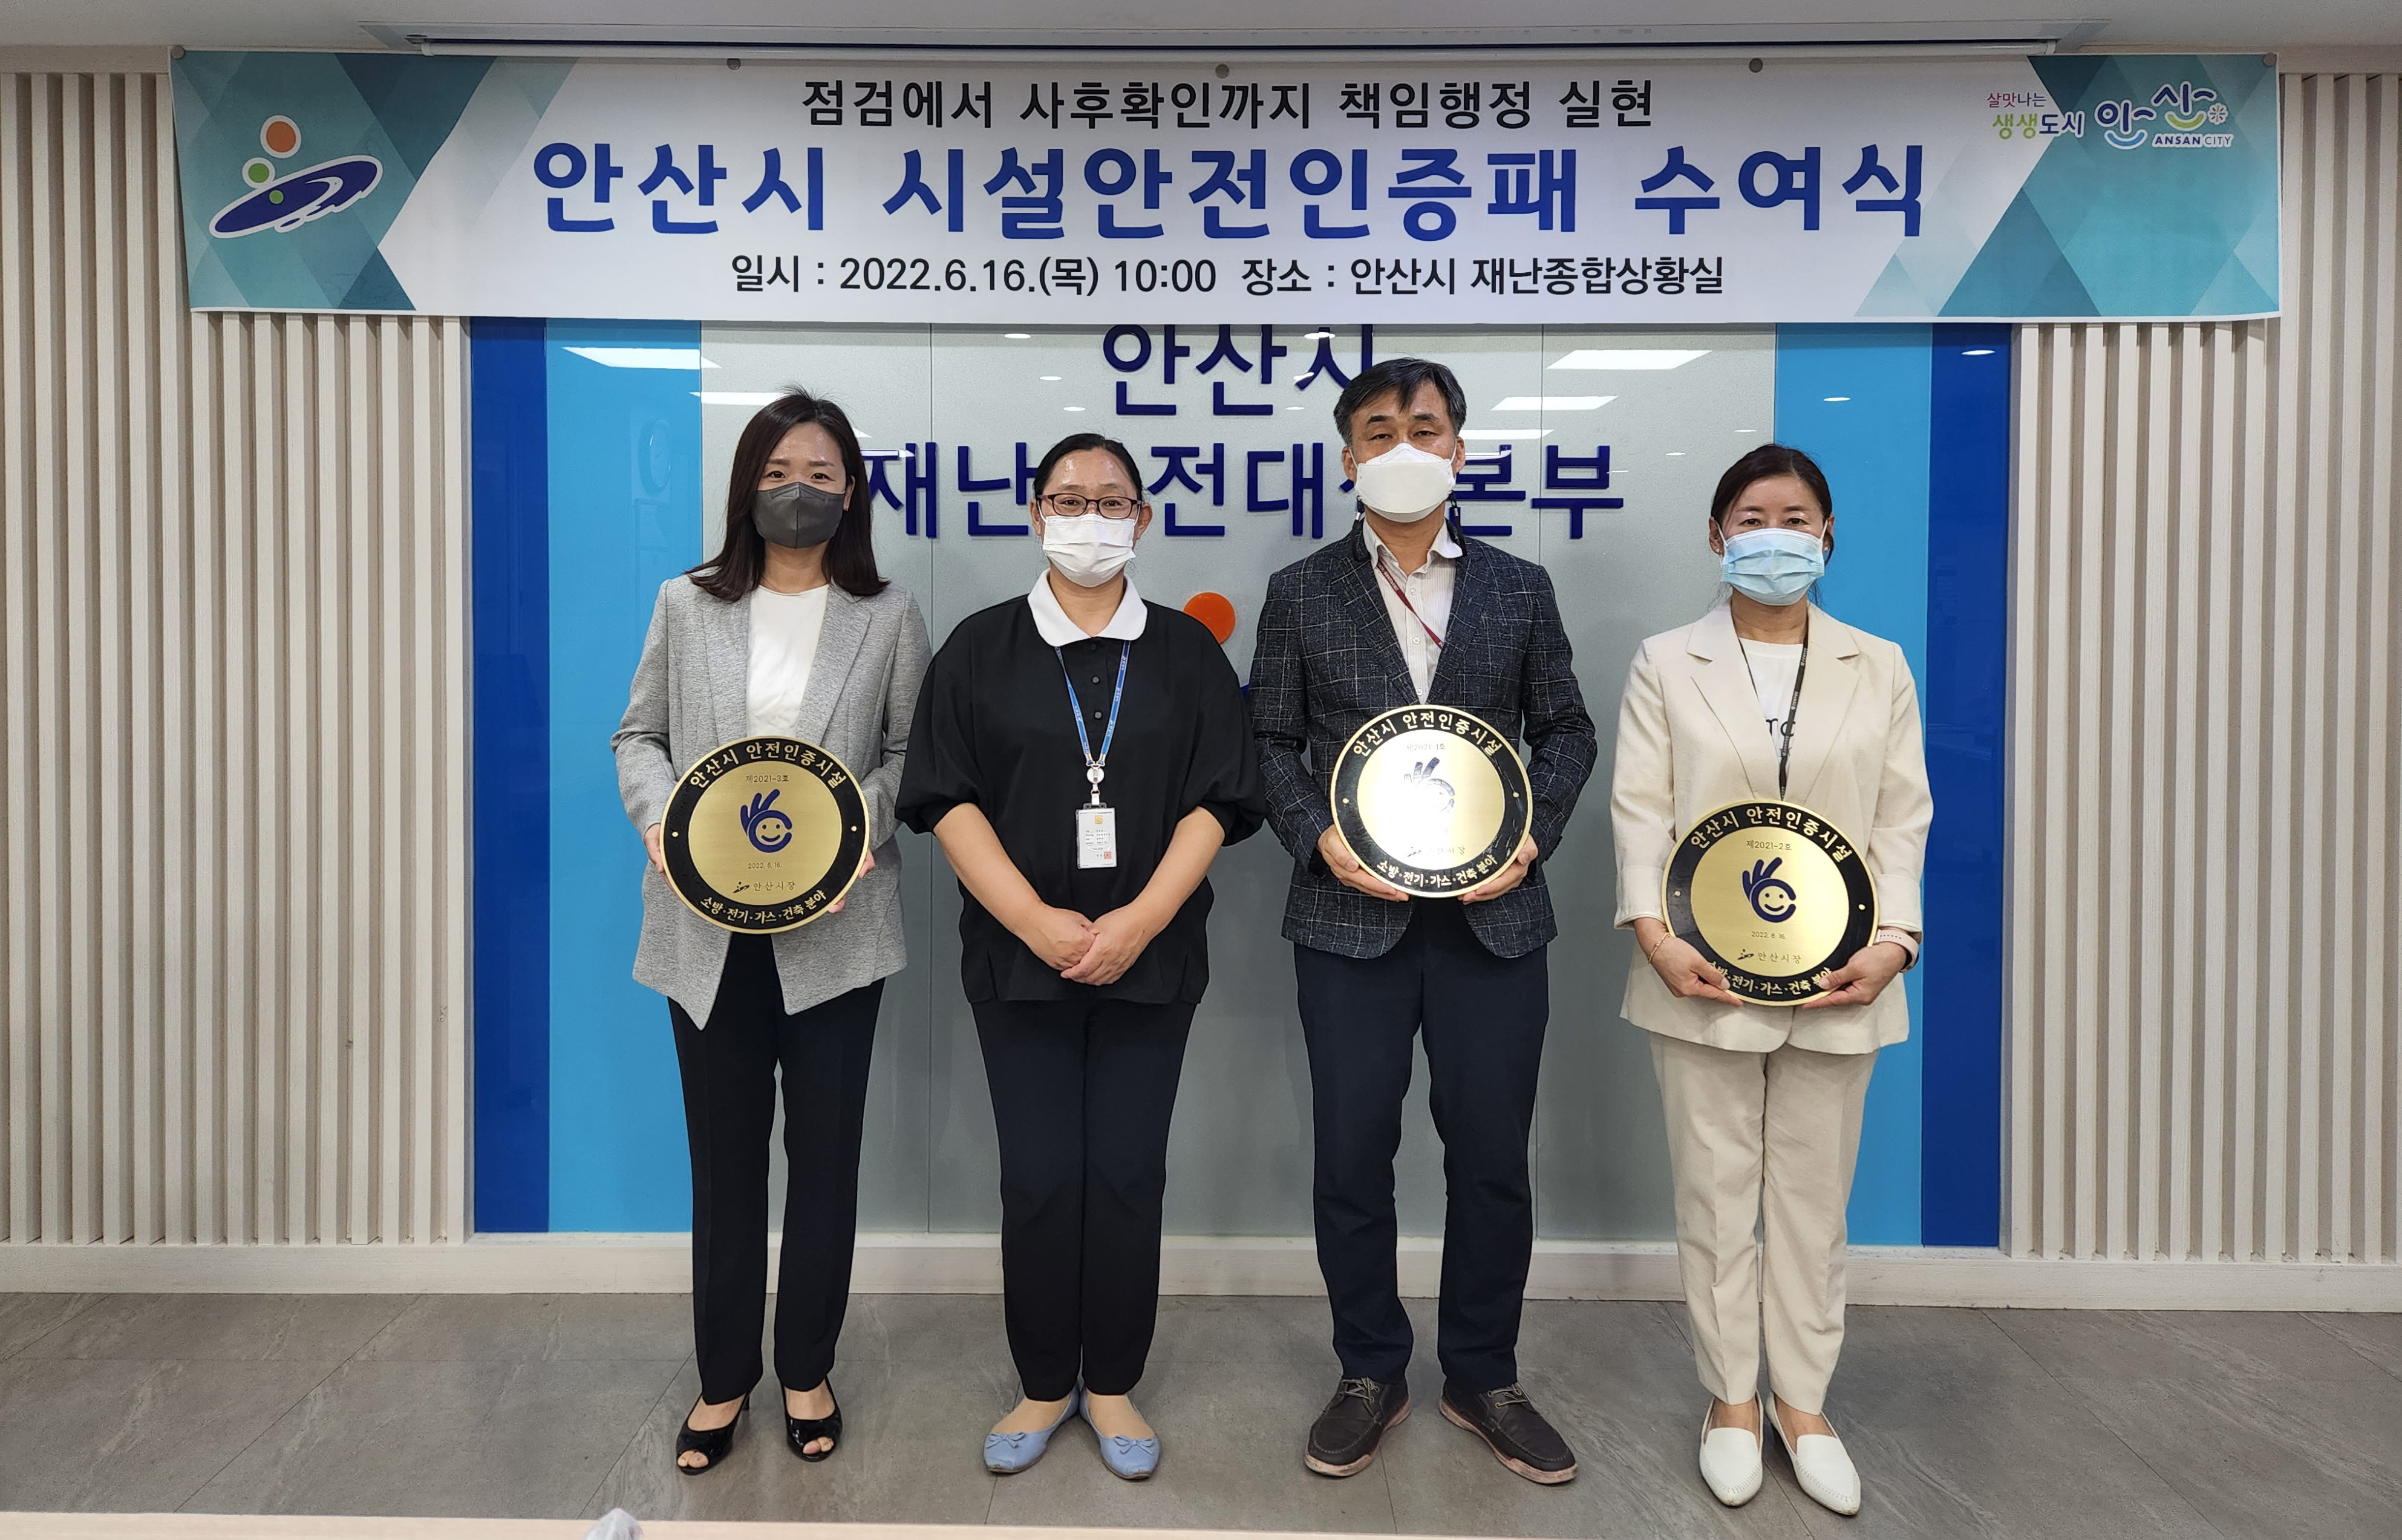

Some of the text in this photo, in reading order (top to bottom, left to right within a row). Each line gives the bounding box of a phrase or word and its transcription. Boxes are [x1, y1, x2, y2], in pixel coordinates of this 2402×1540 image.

[802, 80, 1651, 129] 점검에서 사후확인까지 책임행정 실현
[1987, 93, 2047, 108] 살맛나는
[2097, 83, 2215, 147] 안산
[1992, 112, 2084, 140] 생생도시
[2155, 135, 2231, 145] ANSAN CITY
[534, 143, 1923, 241] 안산시 시설안전인증패 수여식
[732, 255, 798, 292] 일시
[840, 257, 1098, 296] 2022.6.16.(목)
[1115, 259, 1216, 292] 10:00
[1241, 258, 1311, 296] 장소
[1351, 258, 1455, 295] 안산시
[1470, 257, 1723, 295] 재난종합상황실
[1353, 711, 1503, 757] 안산시 안전인증시설
[690, 742, 847, 789] 안산시 안전인증시설
[745, 774, 789, 784] 제2021-3호
[1691, 806, 1853, 863] 안산시 안전인증시설
[1745, 839, 1792, 851] 제2021-2호
[1476, 853, 1498, 873] 분야
[804, 889, 827, 910] 분야
